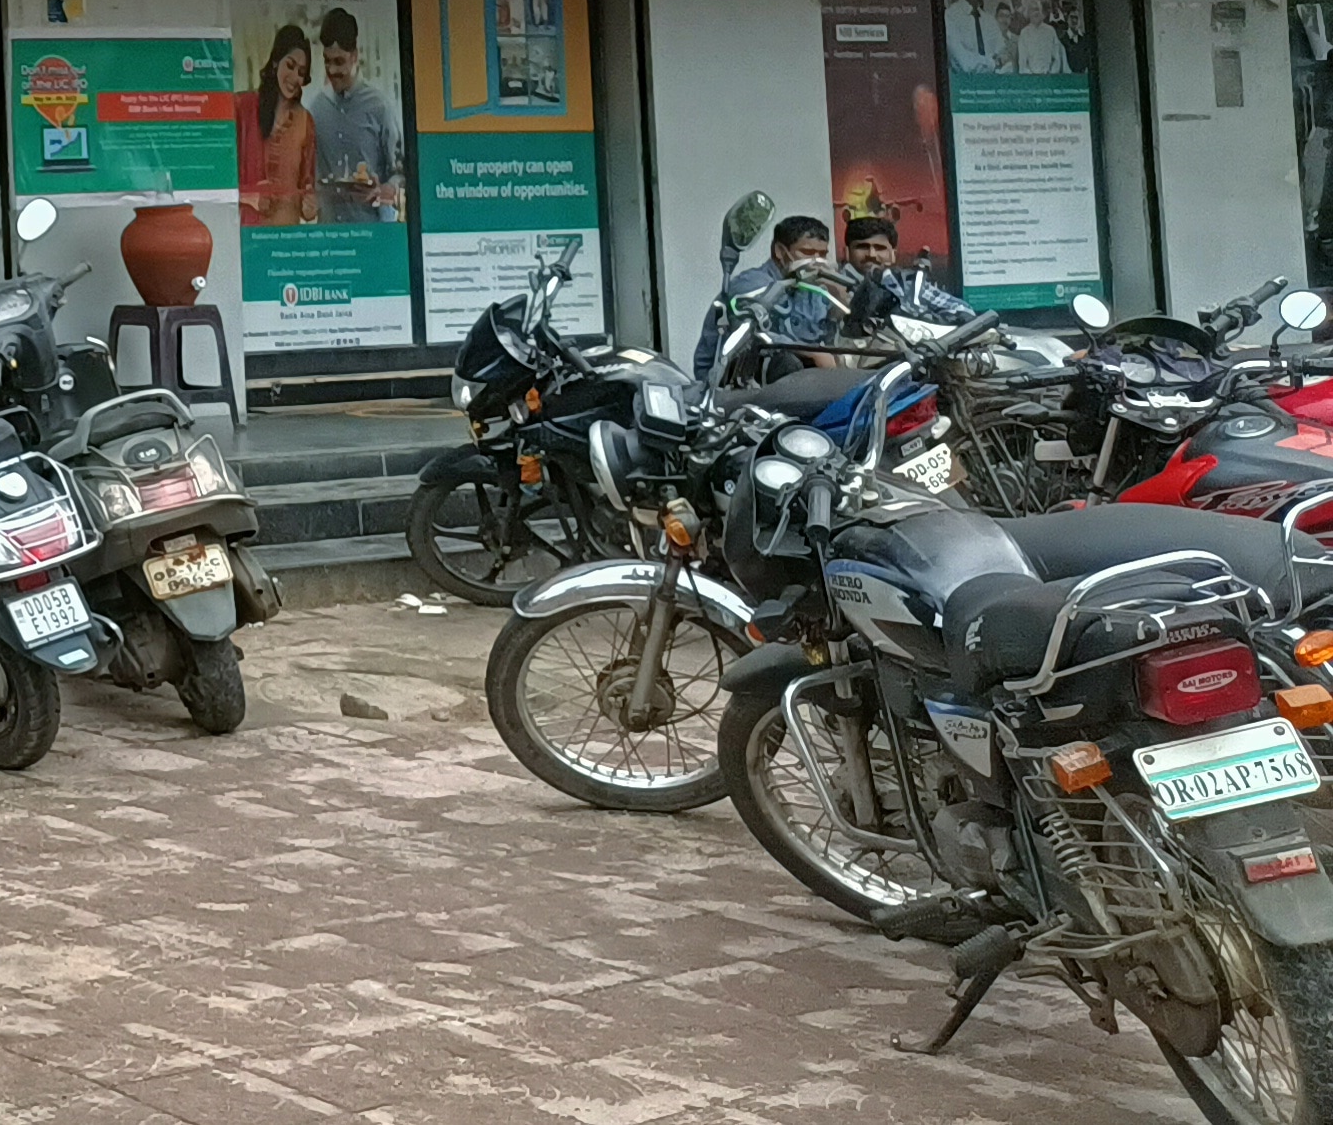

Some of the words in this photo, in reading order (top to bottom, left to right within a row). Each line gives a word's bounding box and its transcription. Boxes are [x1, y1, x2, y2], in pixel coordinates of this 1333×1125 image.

[450, 158, 474, 175] Your
[477, 159, 524, 178] property
[525, 161, 545, 174] can
[546, 160, 574, 175] open
[435, 182, 455, 199] the
[456, 183, 499, 198] window
[500, 181, 512, 197] of
[513, 180, 589, 200] opportunities.
[299, 287, 323, 301] IDBI
[31, 606, 79, 635] E1992
[1198, 671, 1233, 685] MOTORS
